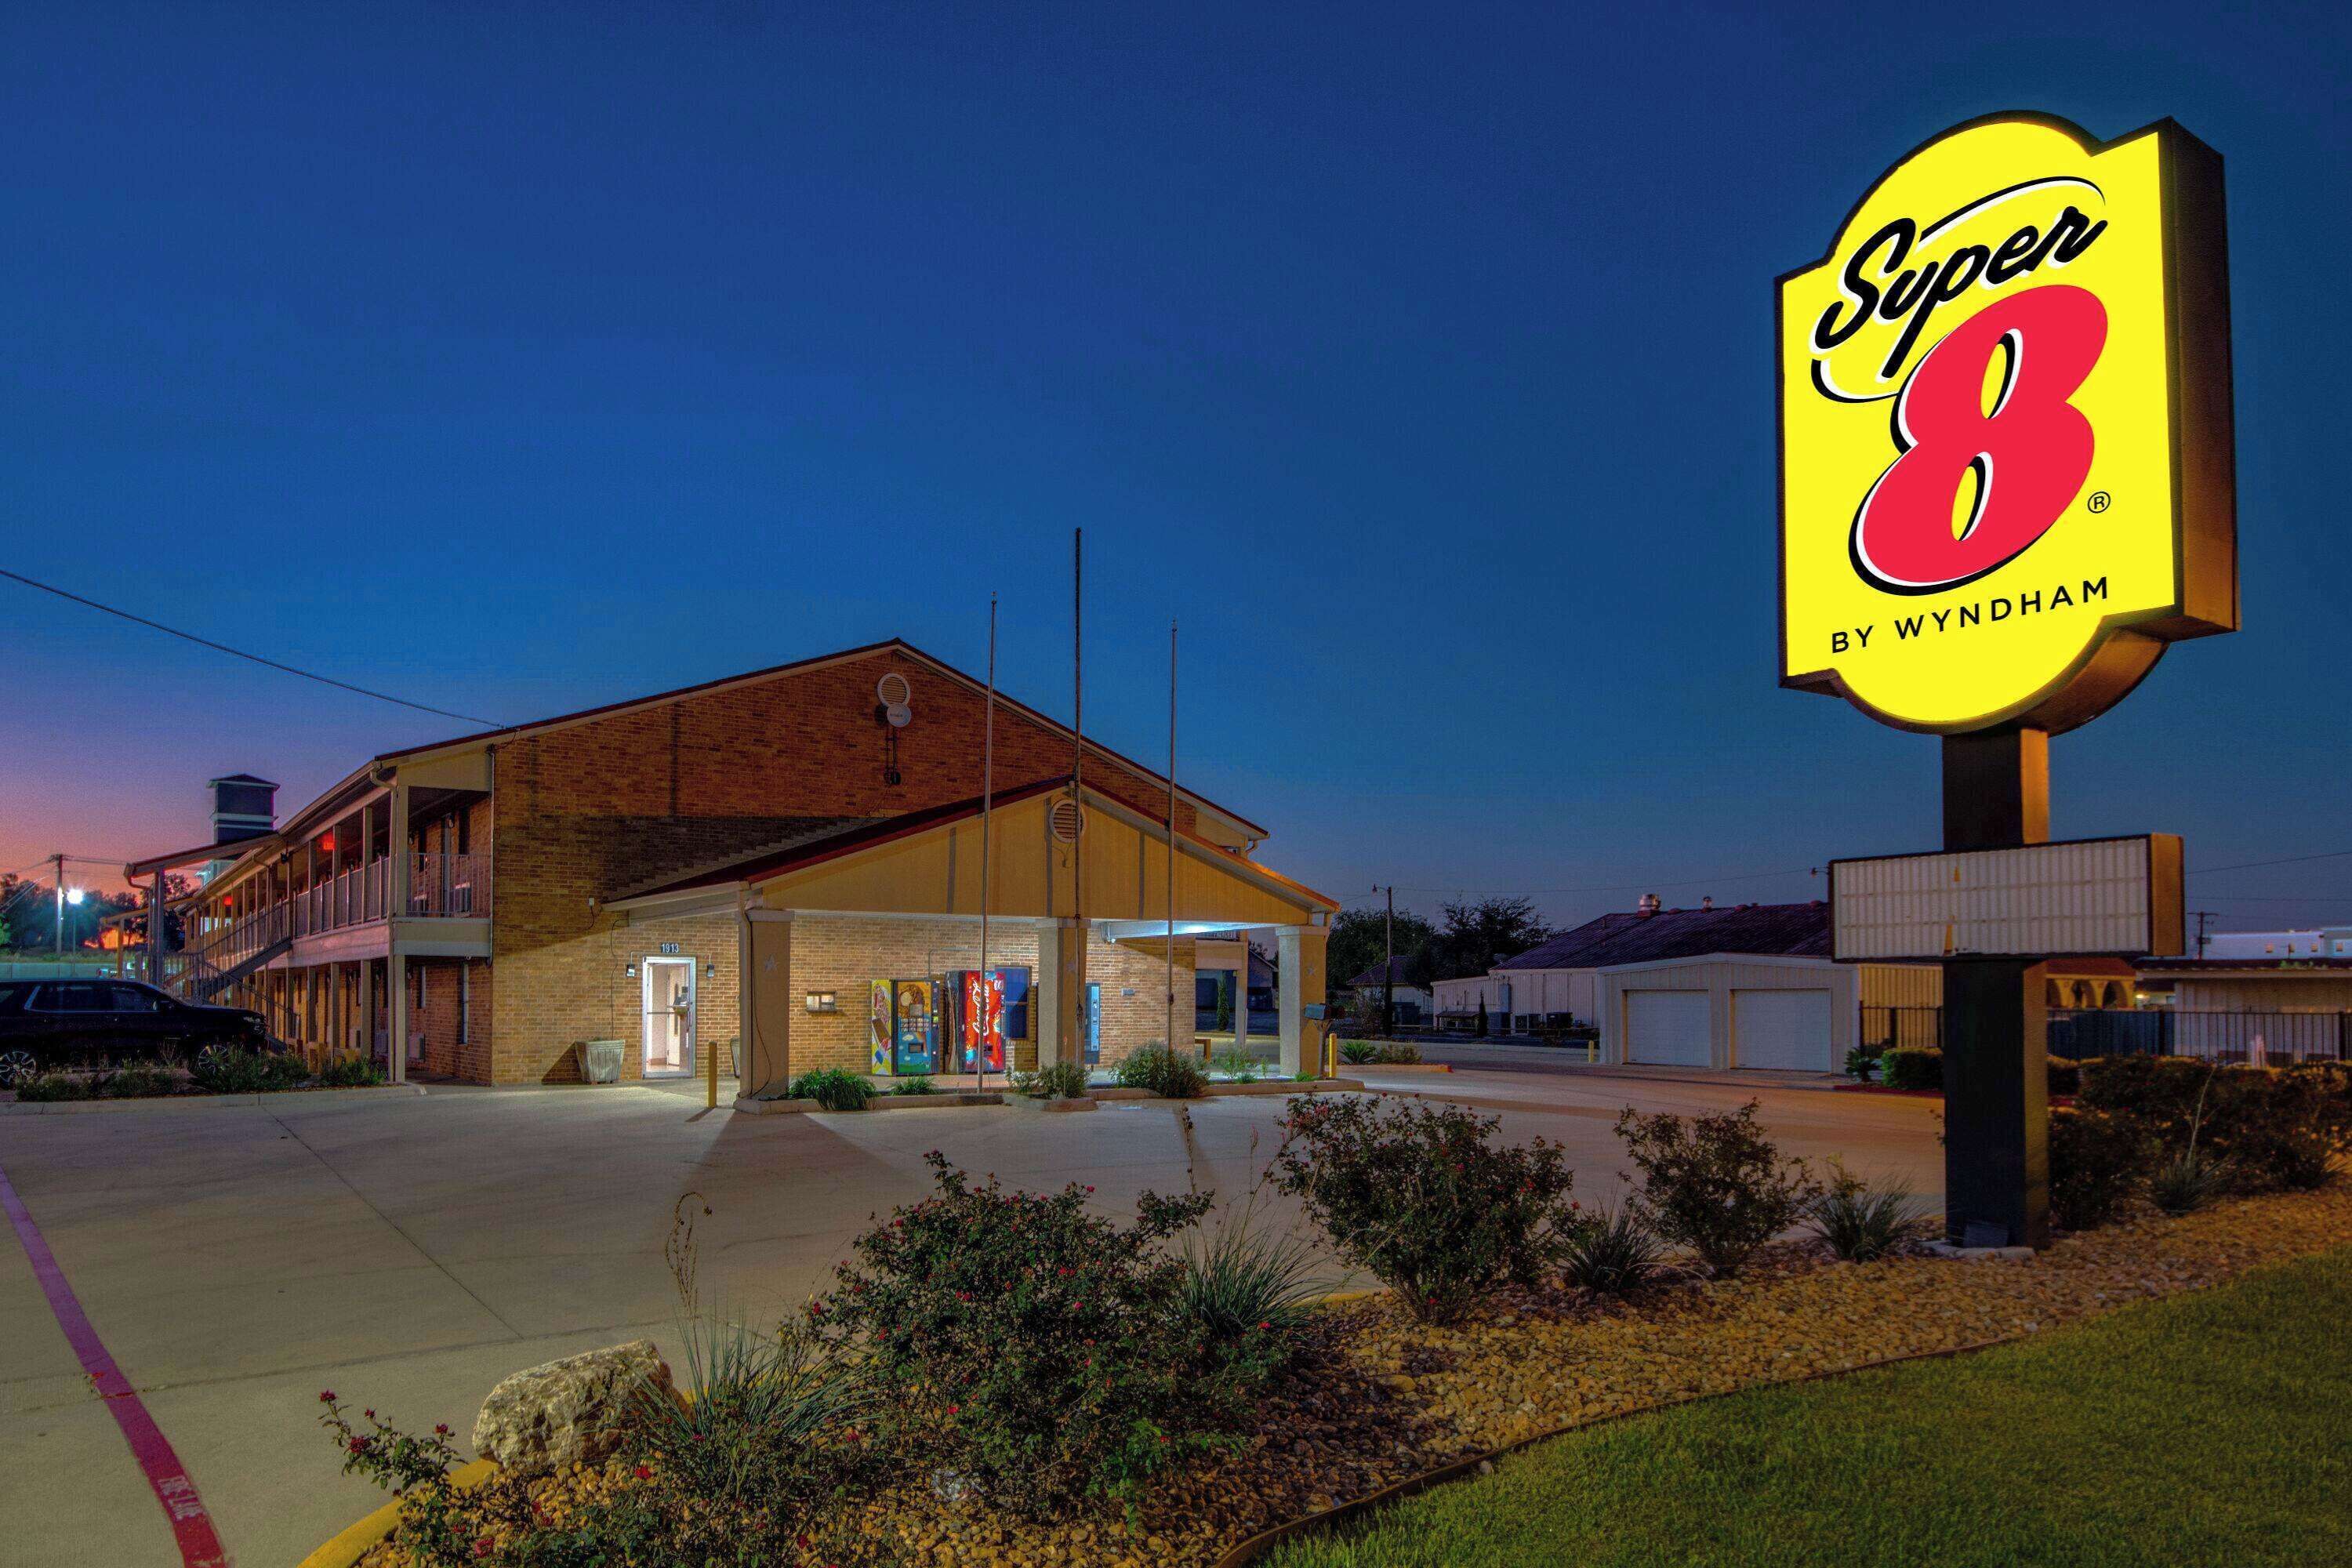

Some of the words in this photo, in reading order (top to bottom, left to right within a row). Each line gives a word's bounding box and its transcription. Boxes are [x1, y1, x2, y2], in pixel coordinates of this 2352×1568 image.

[1813, 205, 2108, 379] Super
[1849, 284, 2108, 596] 8
[1831, 625, 1874, 654] BY
[1894, 576, 2108, 641] WYNDHAM
[661, 943, 679, 953] 1913
